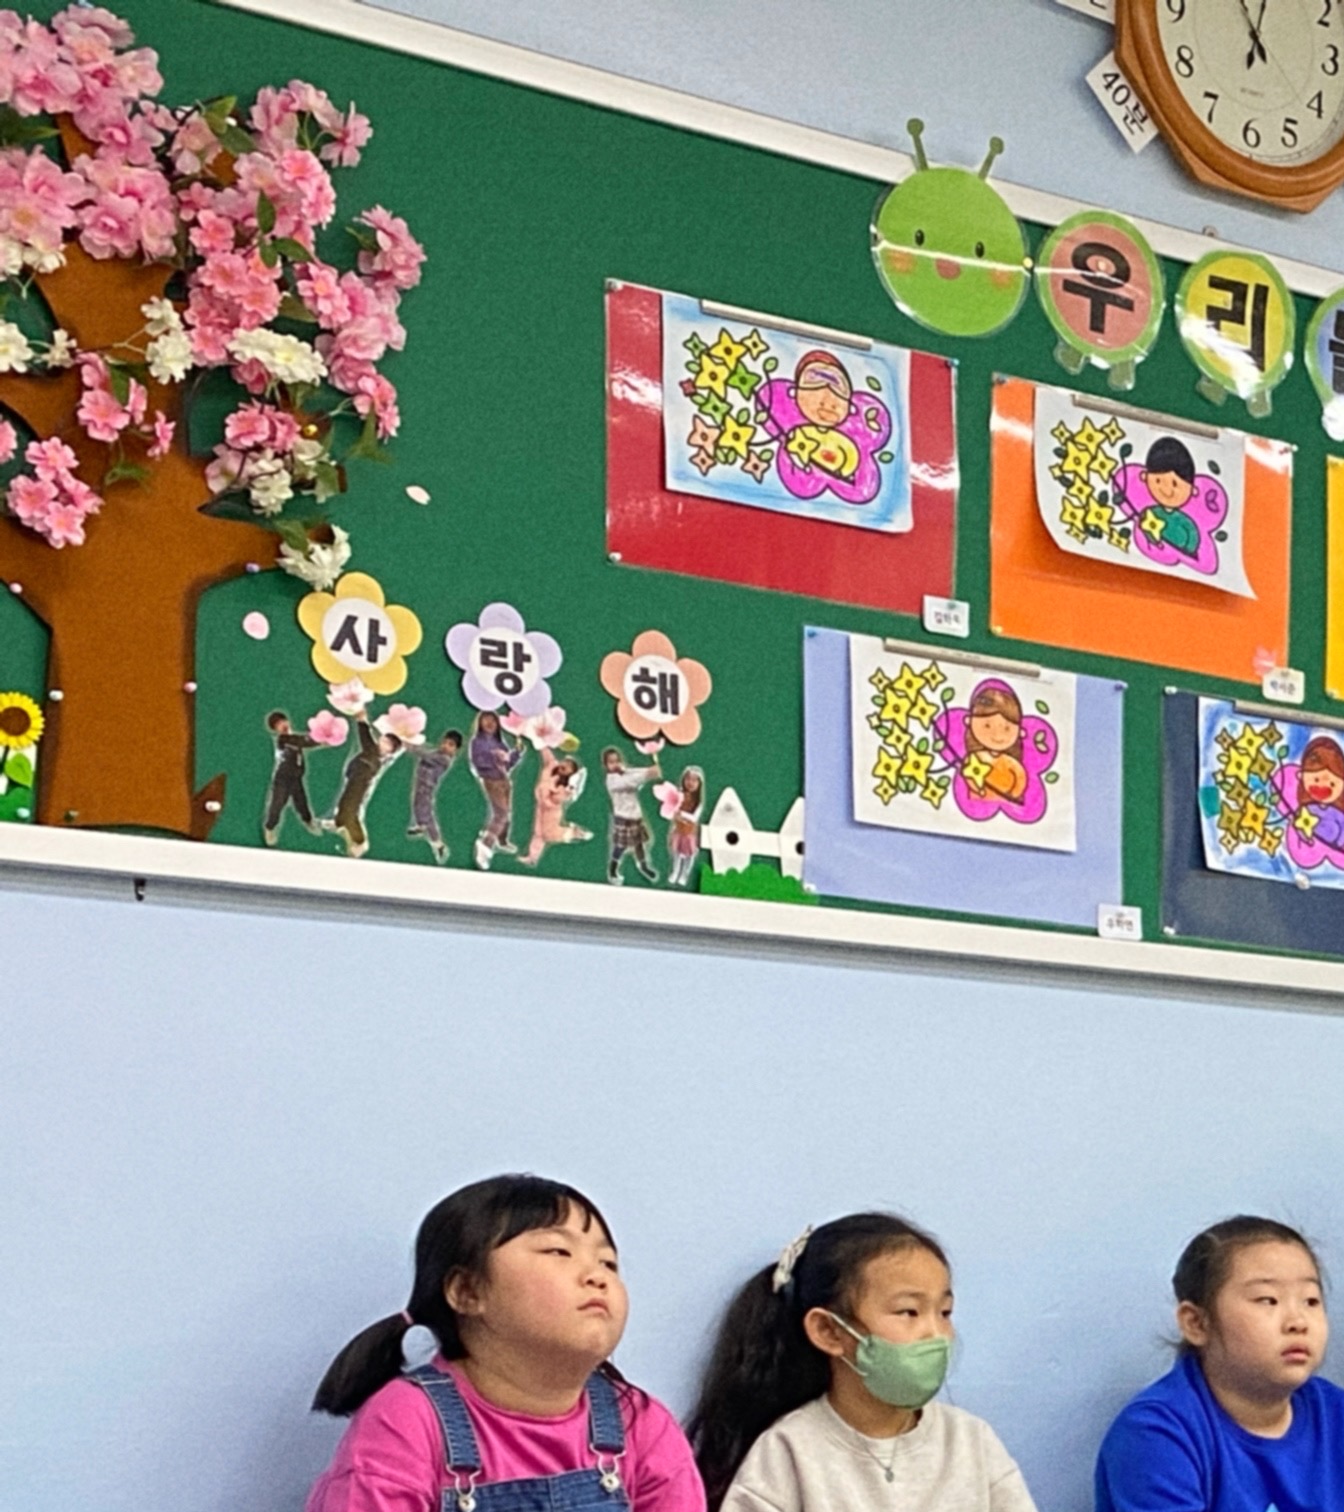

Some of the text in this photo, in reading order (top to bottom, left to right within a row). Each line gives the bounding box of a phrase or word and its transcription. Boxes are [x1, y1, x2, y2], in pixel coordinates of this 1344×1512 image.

[1175, 44, 1195, 78] 8
[1320, 44, 1339, 77] 3
[1101, 70, 1149, 136] 40분
[1203, 91, 1220, 123] 7
[1306, 90, 1324, 119] 4
[1242, 118, 1261, 149] 6
[1280, 117, 1299, 149] 5
[329, 613, 680, 716] 사랑해
